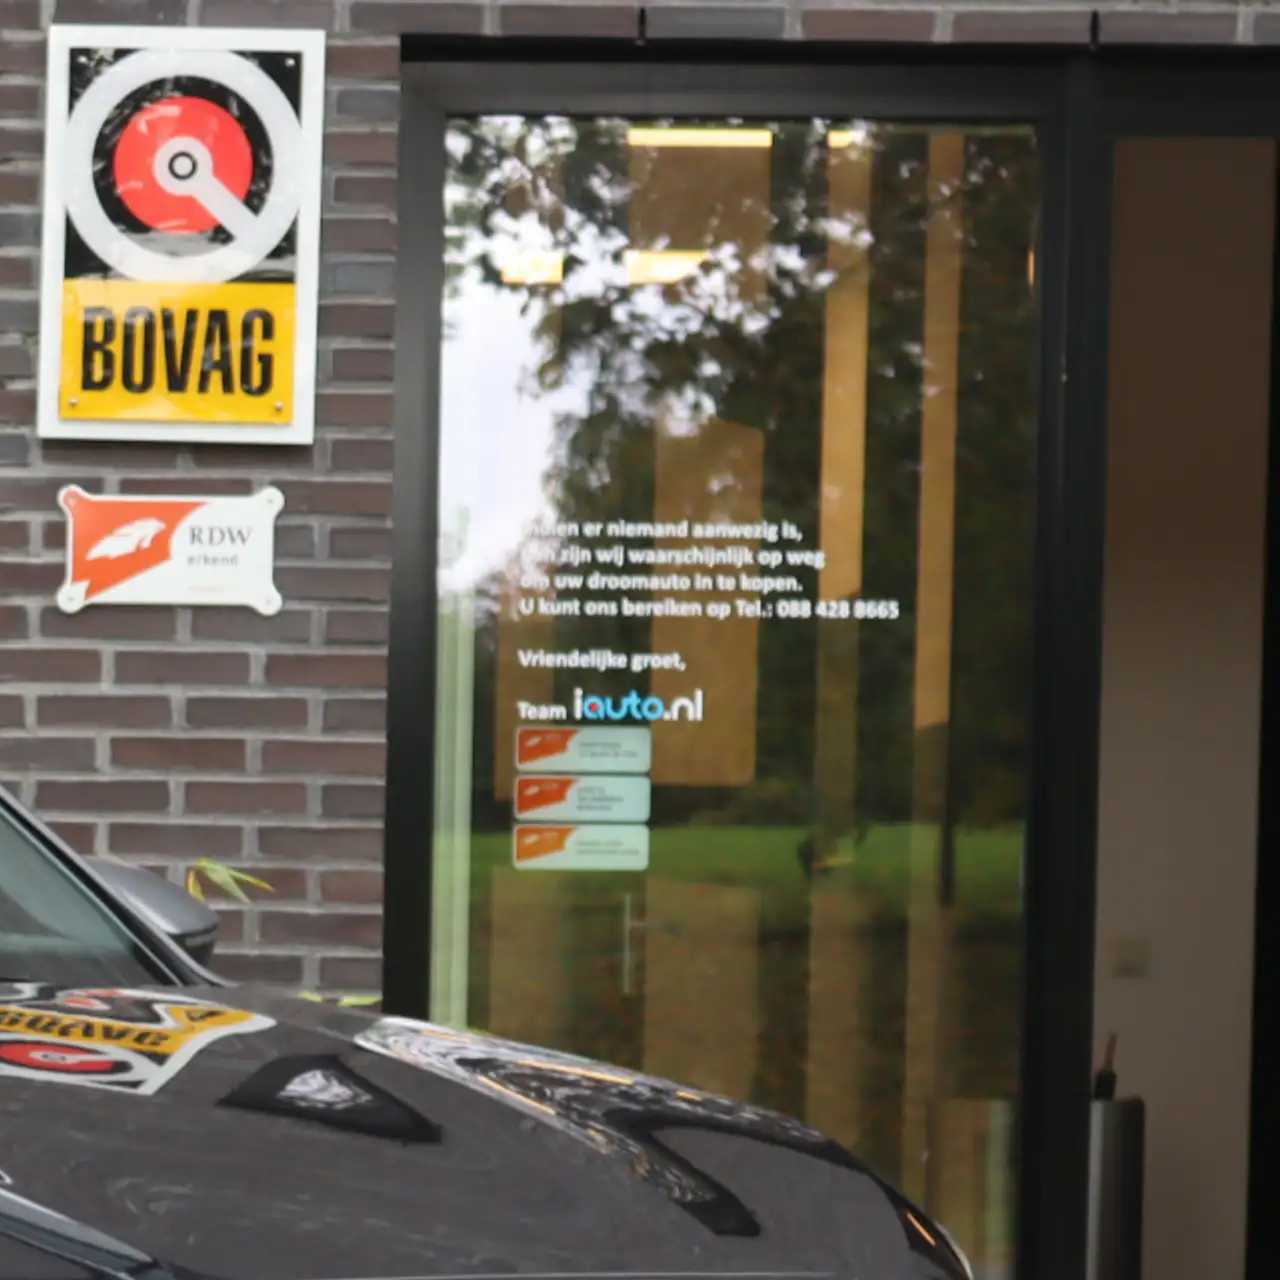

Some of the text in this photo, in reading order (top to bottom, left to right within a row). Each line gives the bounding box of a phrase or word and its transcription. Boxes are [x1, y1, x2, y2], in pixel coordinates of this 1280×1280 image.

[81, 306, 275, 396] BOVAG
[189, 525, 254, 546] RDW
[582, 521, 603, 537] er
[606, 517, 688, 538] niemand
[692, 520, 778, 543] aanwezig
[187, 552, 238, 566] erkend
[595, 544, 624, 567] wij
[627, 545, 754, 568] waarschijnlijk
[757, 550, 782, 568] op
[786, 550, 826, 570] weg
[554, 573, 584, 588] uw
[587, 570, 691, 590] droomauto
[694, 572, 712, 590] in
[716, 573, 736, 590] te
[740, 572, 803, 594] kopen.
[519, 598, 534, 615] U
[538, 596, 581, 616] kunt
[584, 600, 618, 616] ons
[621, 596, 702, 616] bereiken
[705, 602, 731, 620] op
[518, 649, 687, 673] Vriendelijke groet,
[517, 687, 704, 720] Team iauto.nl
